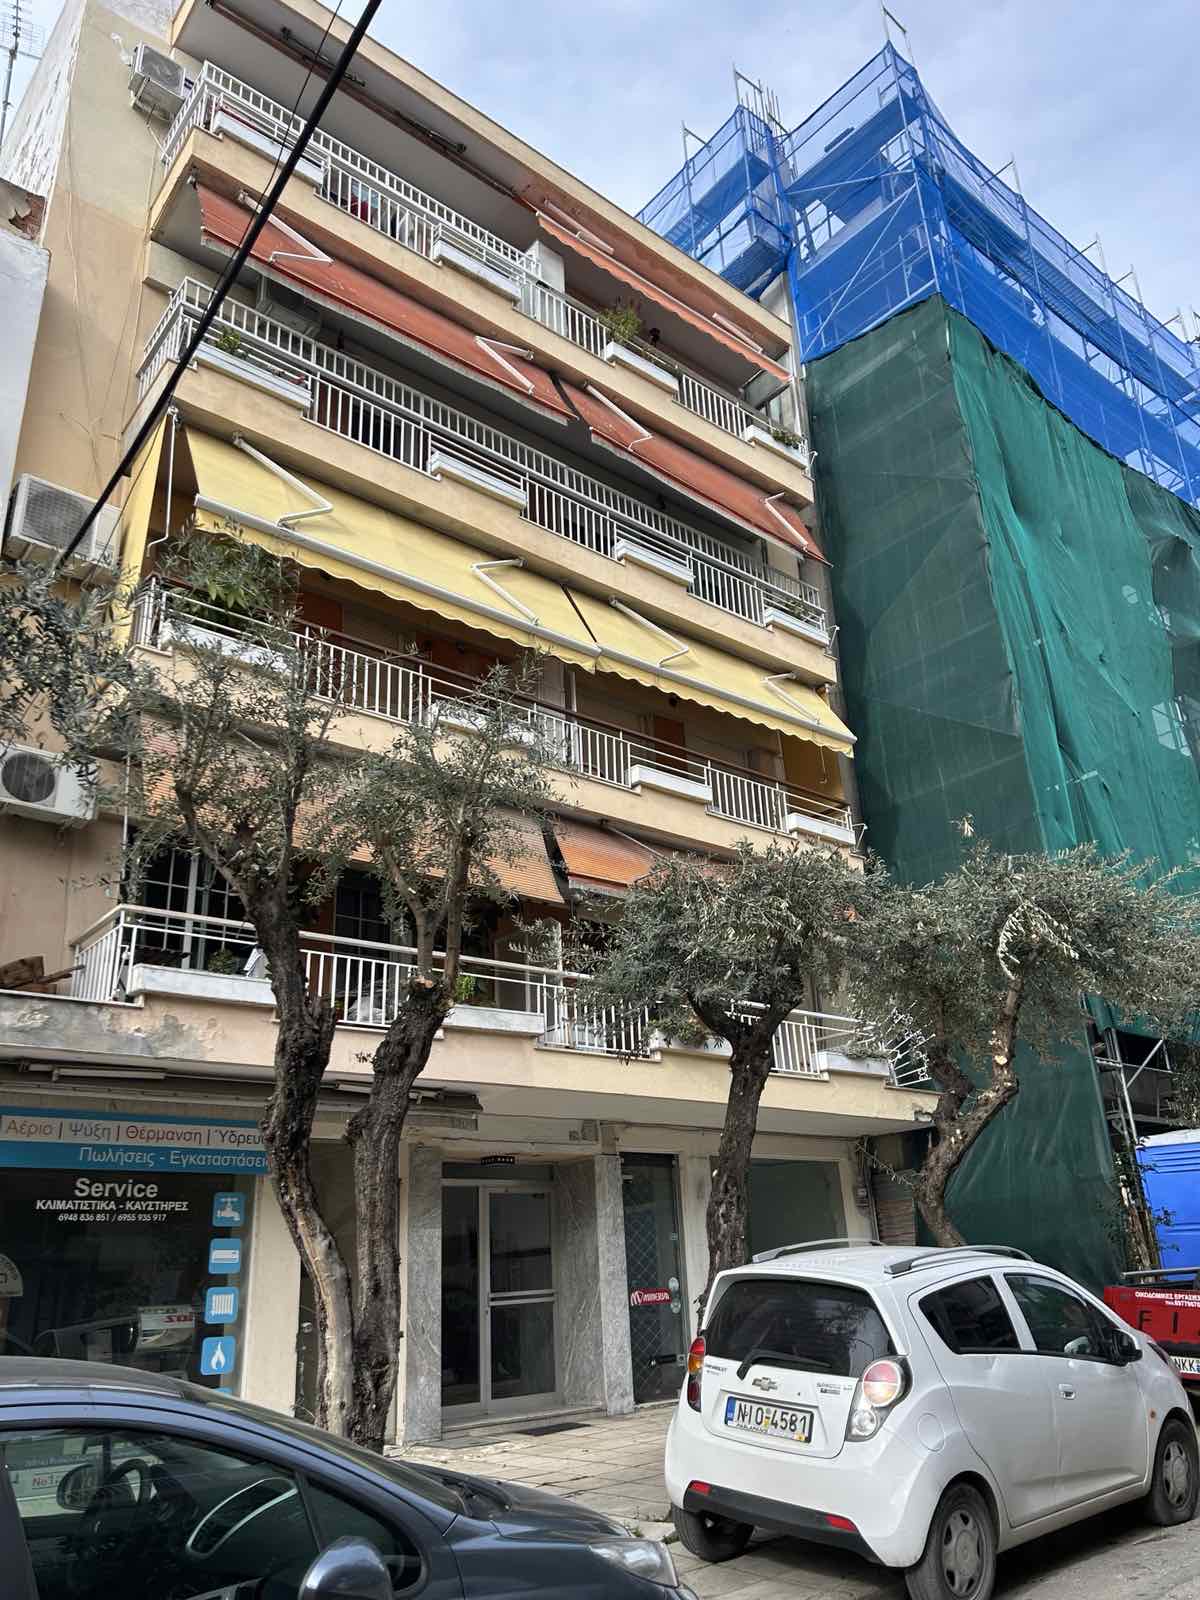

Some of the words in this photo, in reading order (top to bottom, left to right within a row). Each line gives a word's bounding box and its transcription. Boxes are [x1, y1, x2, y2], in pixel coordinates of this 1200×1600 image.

[7, 1120, 53, 1137] Αέριο
[69, 1121, 112, 1141] Ψύξη
[126, 1125, 202, 1145] Θέρμανση
[80, 1146, 156, 1168] Πωλήσεις
[74, 1177, 158, 1198] Service
[36, 1200, 116, 1211] ΚΛΙΜΑΤΙΣΤΙΚΑ
[126, 1201, 189, 1212] ΚΑΥΣΤΗΡΕΣ
